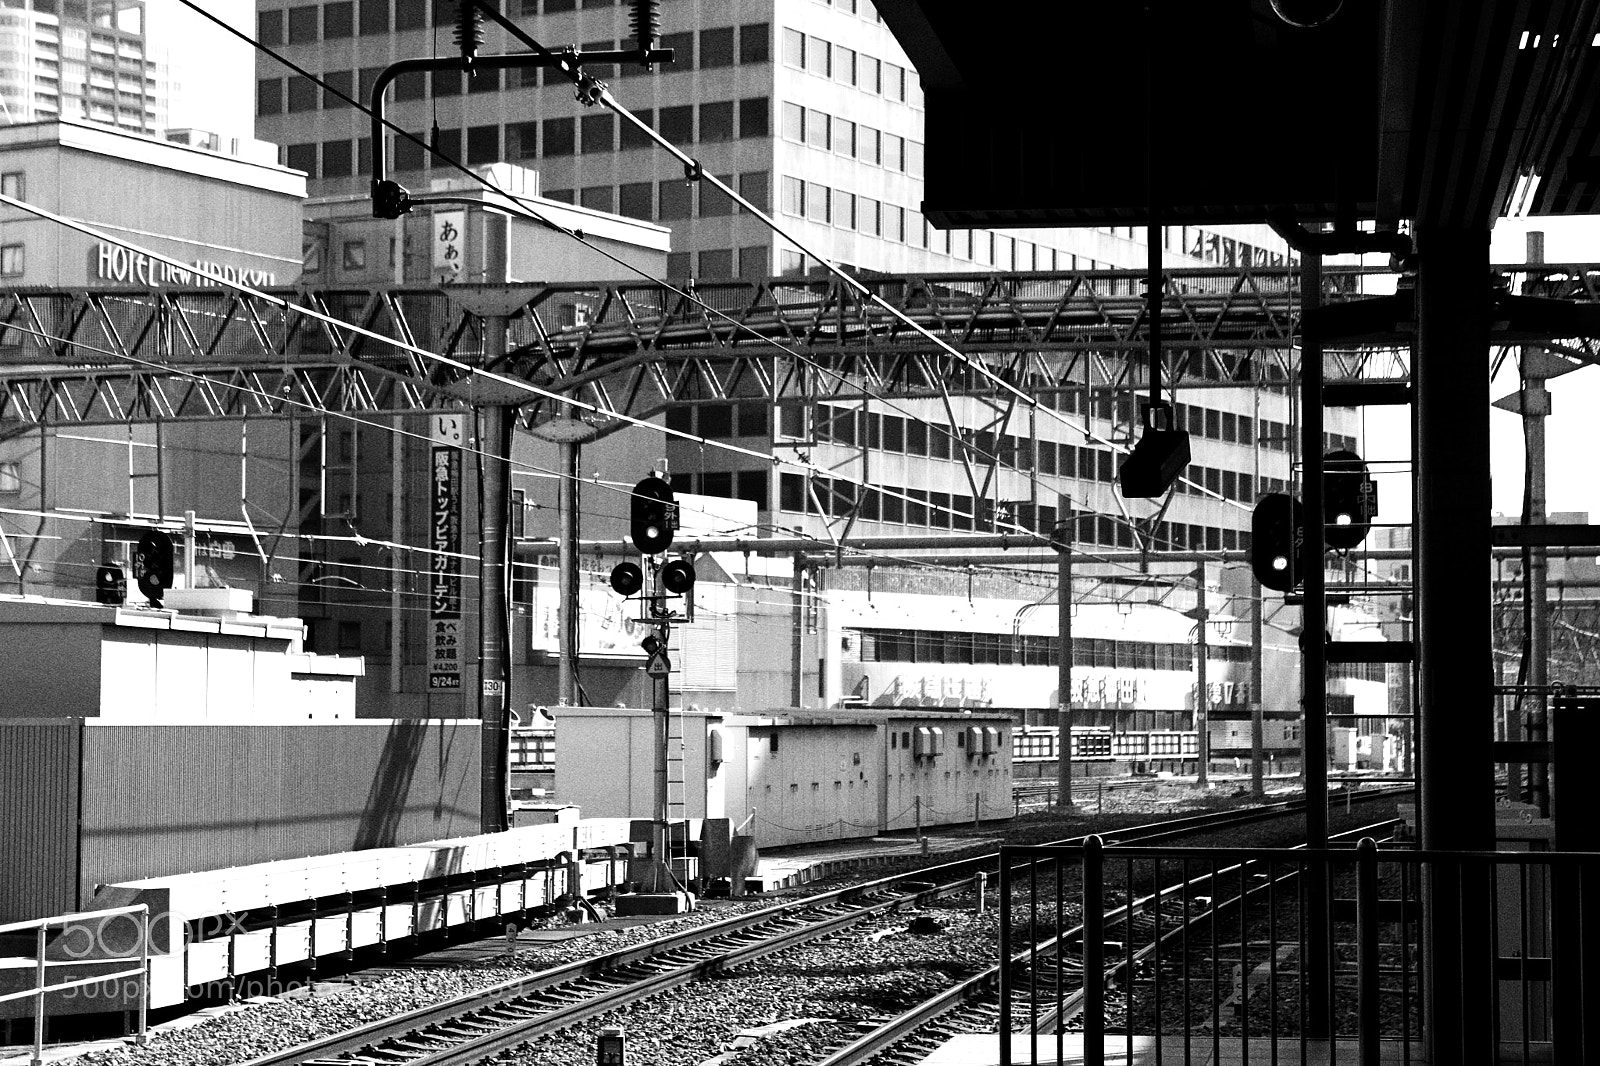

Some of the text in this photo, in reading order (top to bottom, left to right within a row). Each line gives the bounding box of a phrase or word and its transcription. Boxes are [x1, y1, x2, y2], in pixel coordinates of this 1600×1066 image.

[98, 242, 159, 287] HOTEL
[435, 451, 449, 614] 阪急トップビアガーデン
